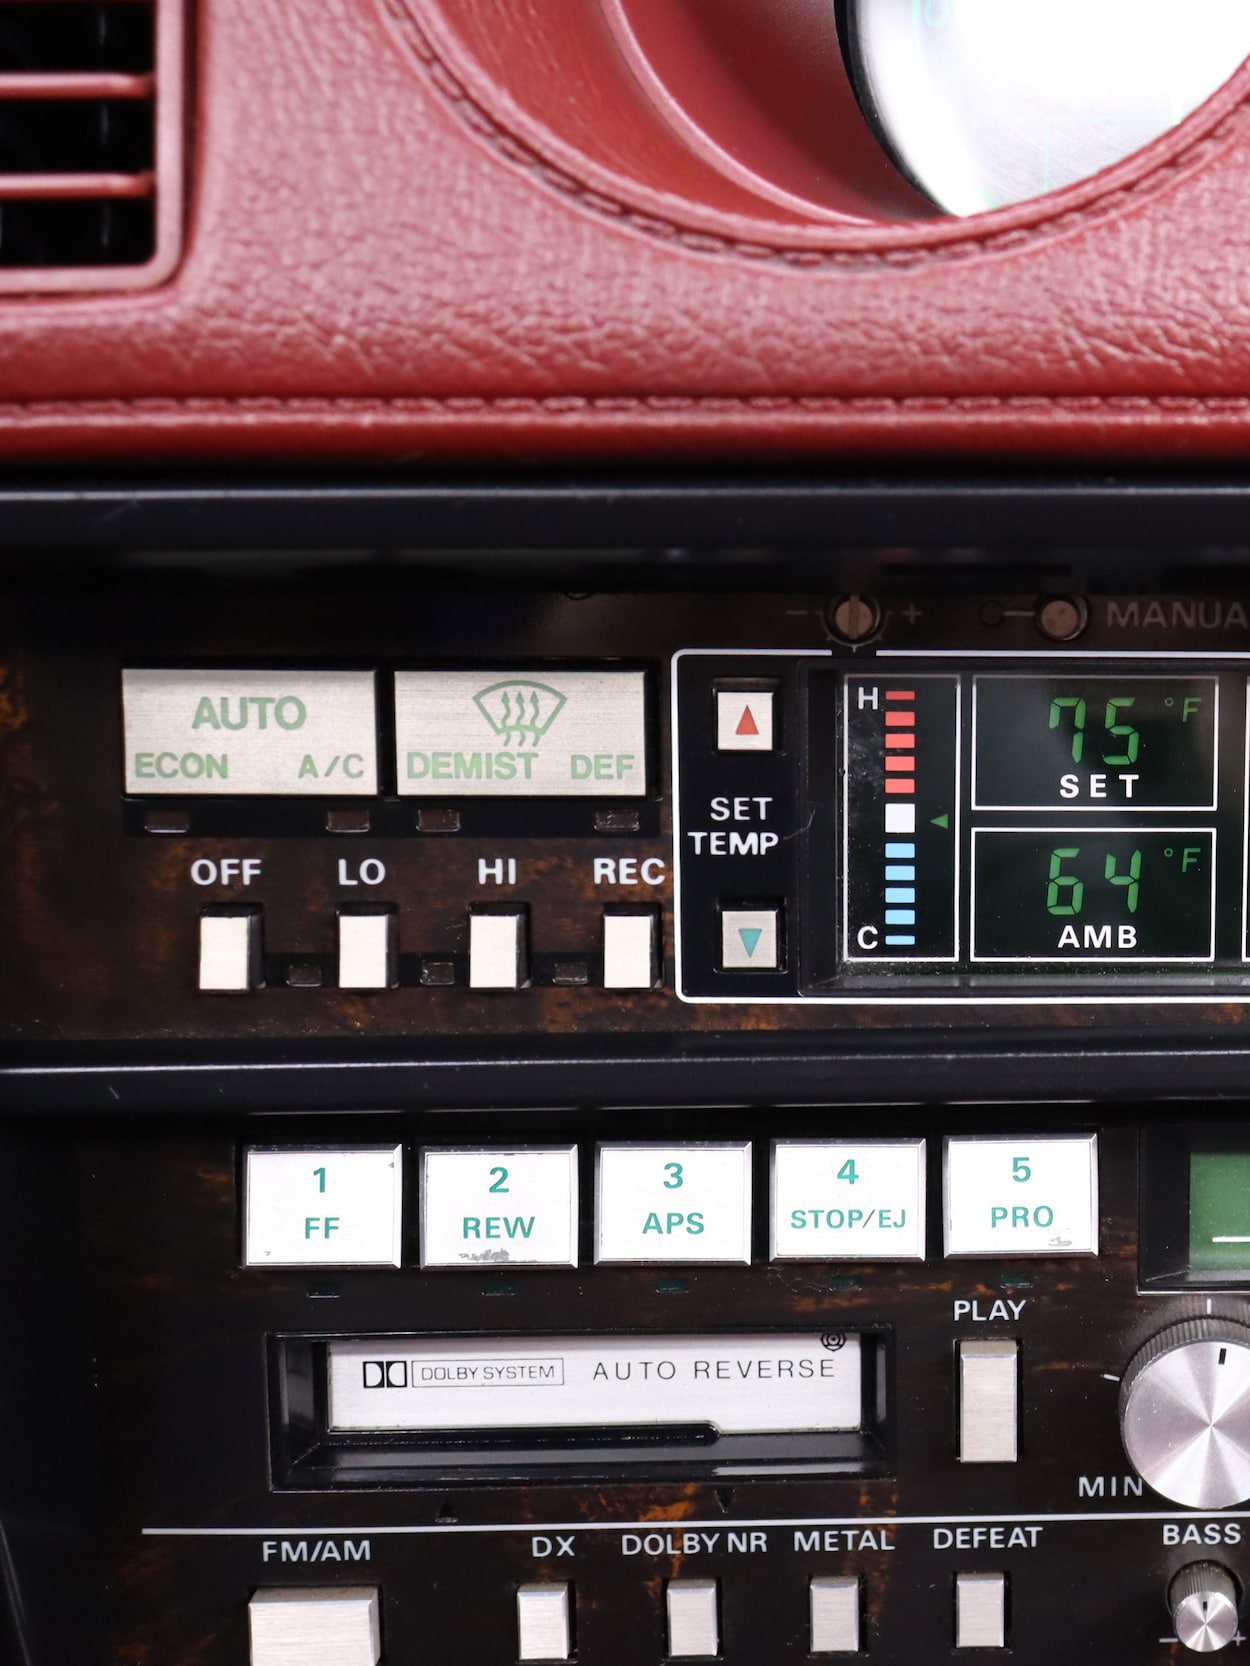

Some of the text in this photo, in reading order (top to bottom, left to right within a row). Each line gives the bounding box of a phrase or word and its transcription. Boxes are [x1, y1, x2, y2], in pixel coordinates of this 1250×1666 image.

[858, 687, 879, 710] H
[192, 695, 307, 731] AUTO
[1048, 697, 1140, 766] 75
[134, 752, 365, 780] ECON A/C
[406, 752, 636, 780] DEMIST DEF
[1059, 773, 1140, 799] SET
[709, 796, 773, 822] SET
[687, 832, 779, 856] TEMP
[190, 858, 263, 886] OFF
[338, 858, 386, 885] LO
[477, 857, 517, 885] HI
[593, 857, 666, 885] REC
[1046, 848, 1142, 915] 64
[857, 925, 879, 950] C
[1056, 925, 1138, 949] AMB
[311, 1166, 328, 1193] 1
[487, 1165, 510, 1194] 2
[662, 1162, 686, 1190] 3
[836, 1159, 859, 1185] 4
[1011, 1157, 1032, 1183] 5
[303, 1216, 341, 1240] FF
[462, 1215, 536, 1239] REW
[641, 1212, 705, 1236] APS
[789, 1208, 908, 1230] STOP/EJ
[989, 1206, 1055, 1229] PRO
[953, 1299, 1027, 1322] PLAY
[421, 1364, 555, 1382] DOLBY SYSTEM
[592, 1359, 836, 1382] AUTO REVERSE
[1078, 1475, 1143, 1498] MIN
[531, 1535, 576, 1557] DX
[620, 1532, 768, 1556] DOLBY NR
[792, 1529, 895, 1553] METAL
[932, 1526, 1044, 1550] DEFEAT
[1162, 1524, 1242, 1546] BASS
[261, 1539, 372, 1562] FM/AM
